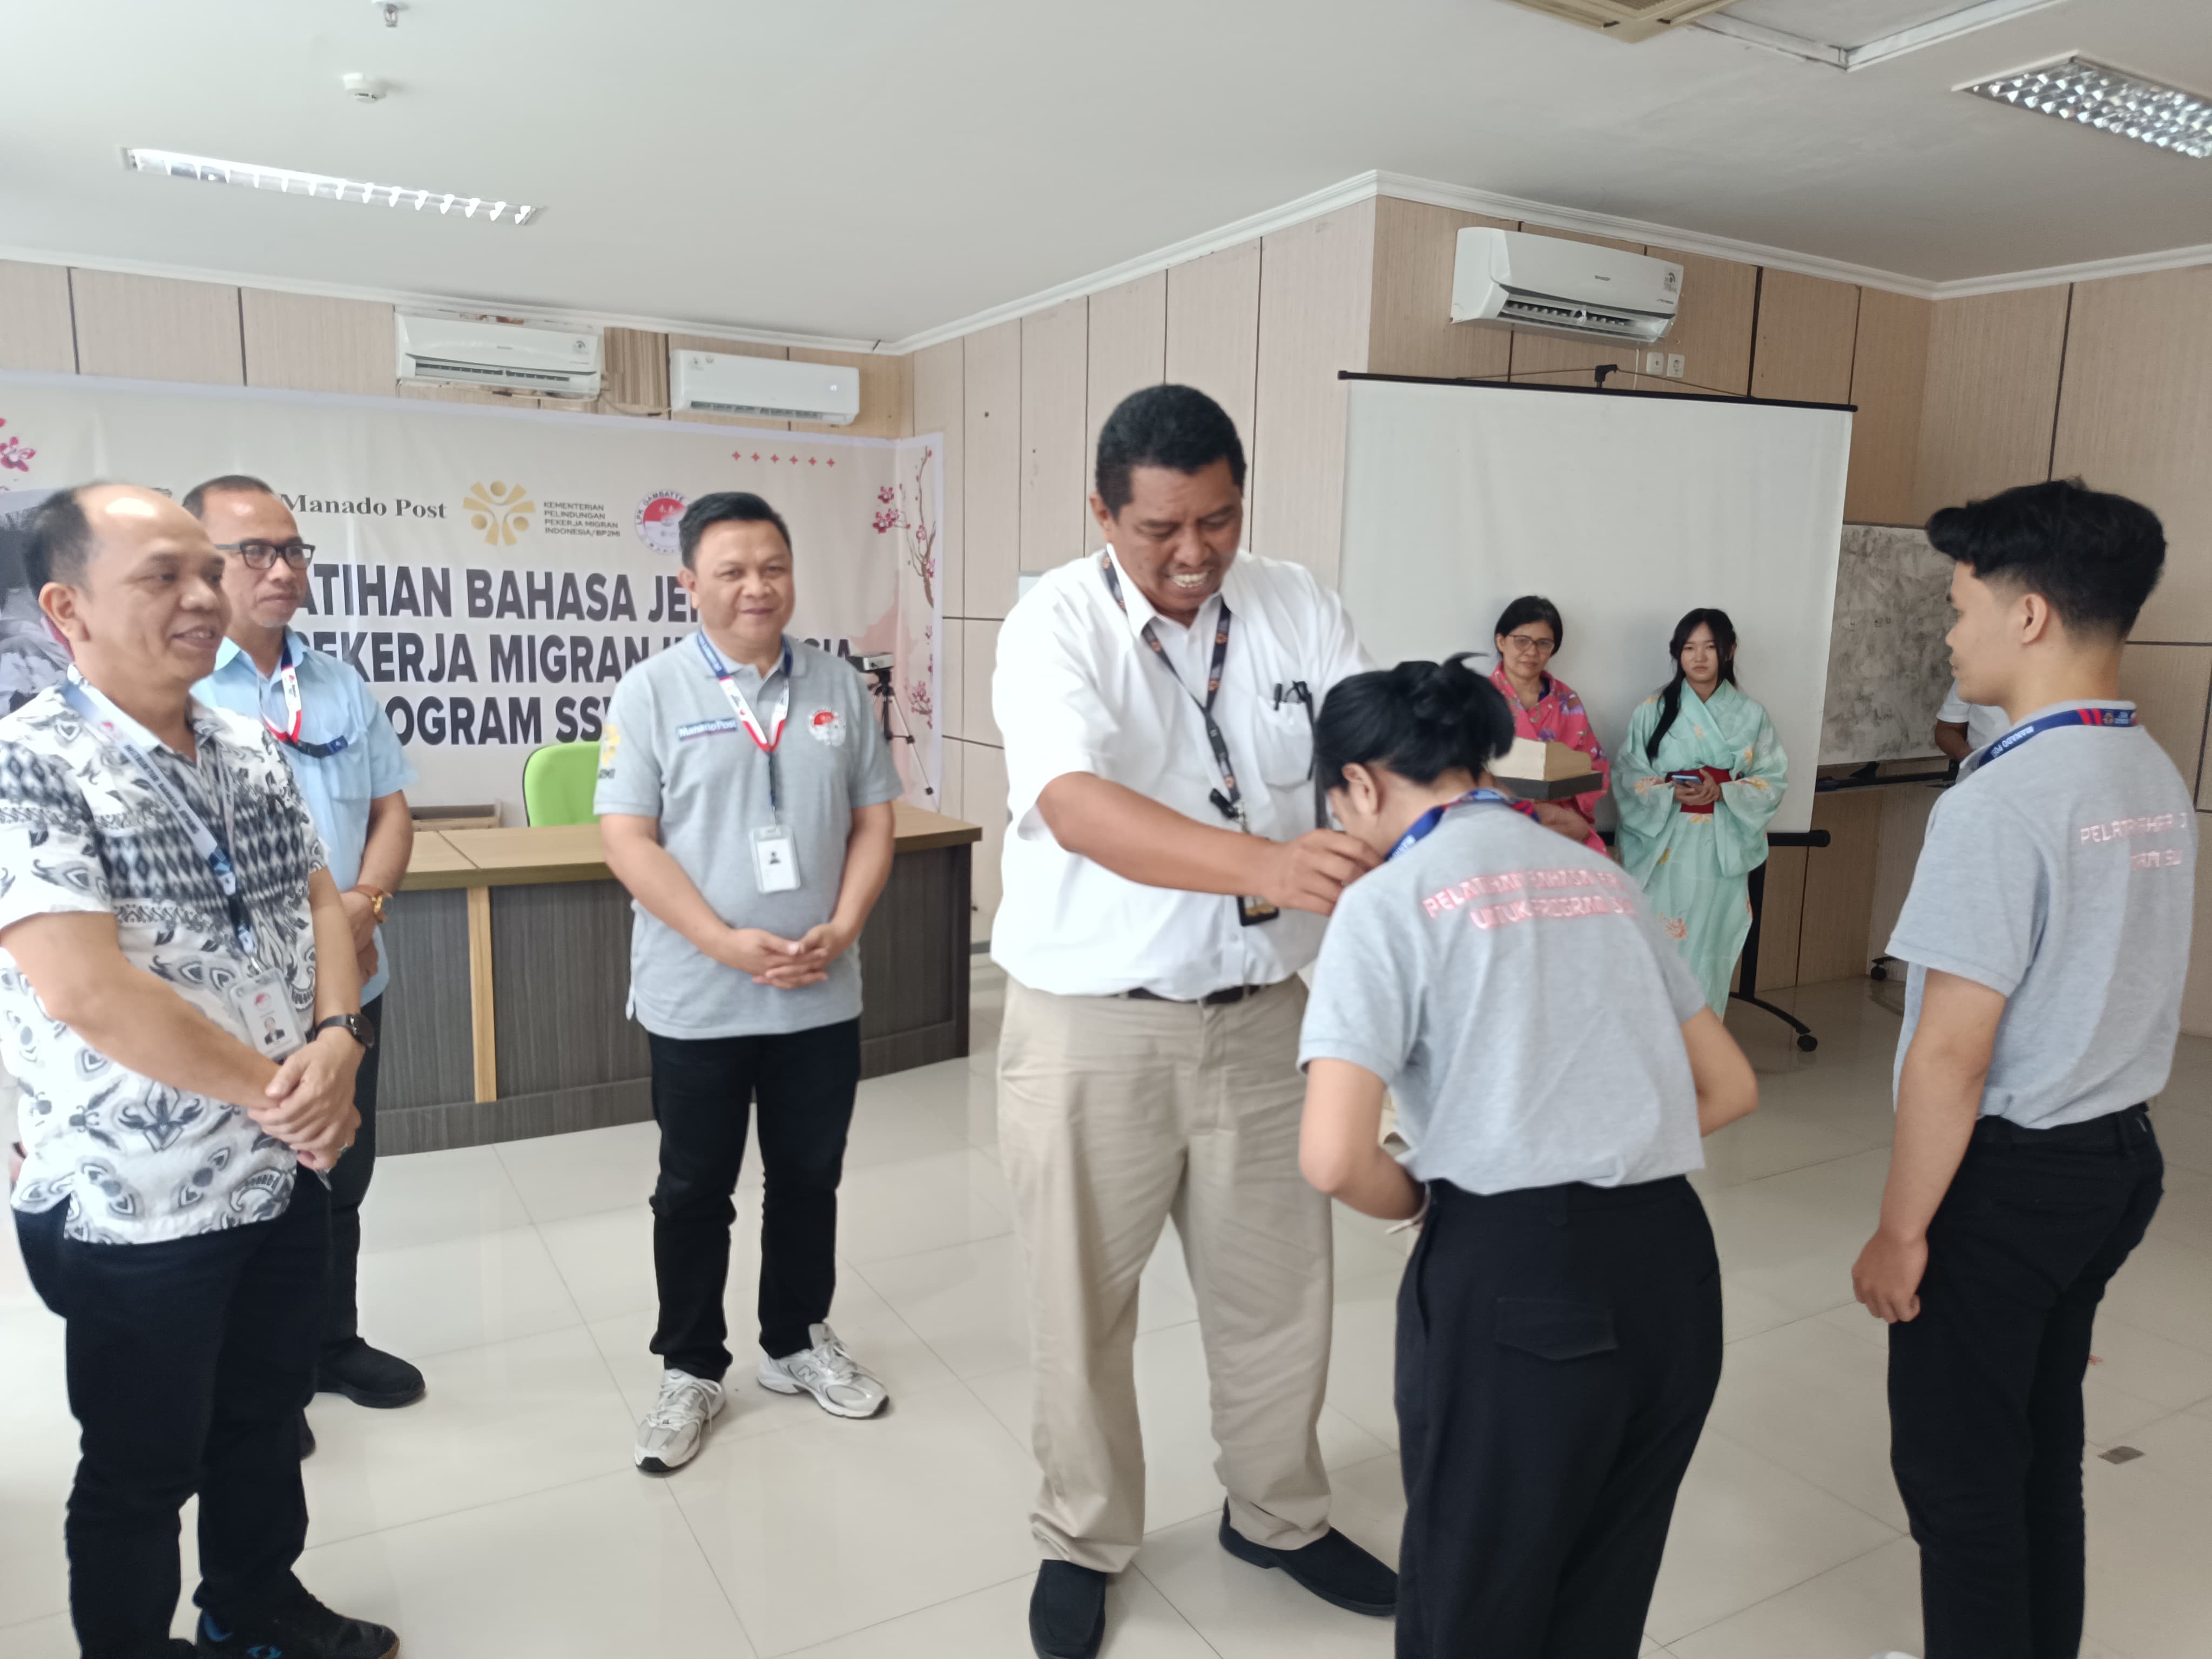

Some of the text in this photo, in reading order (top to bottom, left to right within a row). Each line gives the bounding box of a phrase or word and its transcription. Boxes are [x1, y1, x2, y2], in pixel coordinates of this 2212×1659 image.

[281, 494, 448, 519] Manado Post
[544, 502, 604, 511] KEMENTERIAN
[544, 510, 605, 520] PELINDUNGAN
[545, 519, 618, 529] PEKERJA MIGRAN
[466, 569, 637, 622] BAHASA
[648, 576, 698, 623] JE
[294, 631, 478, 683] KERJA
[489, 634, 649, 684] MIGRAN
[556, 696, 611, 743] SS
